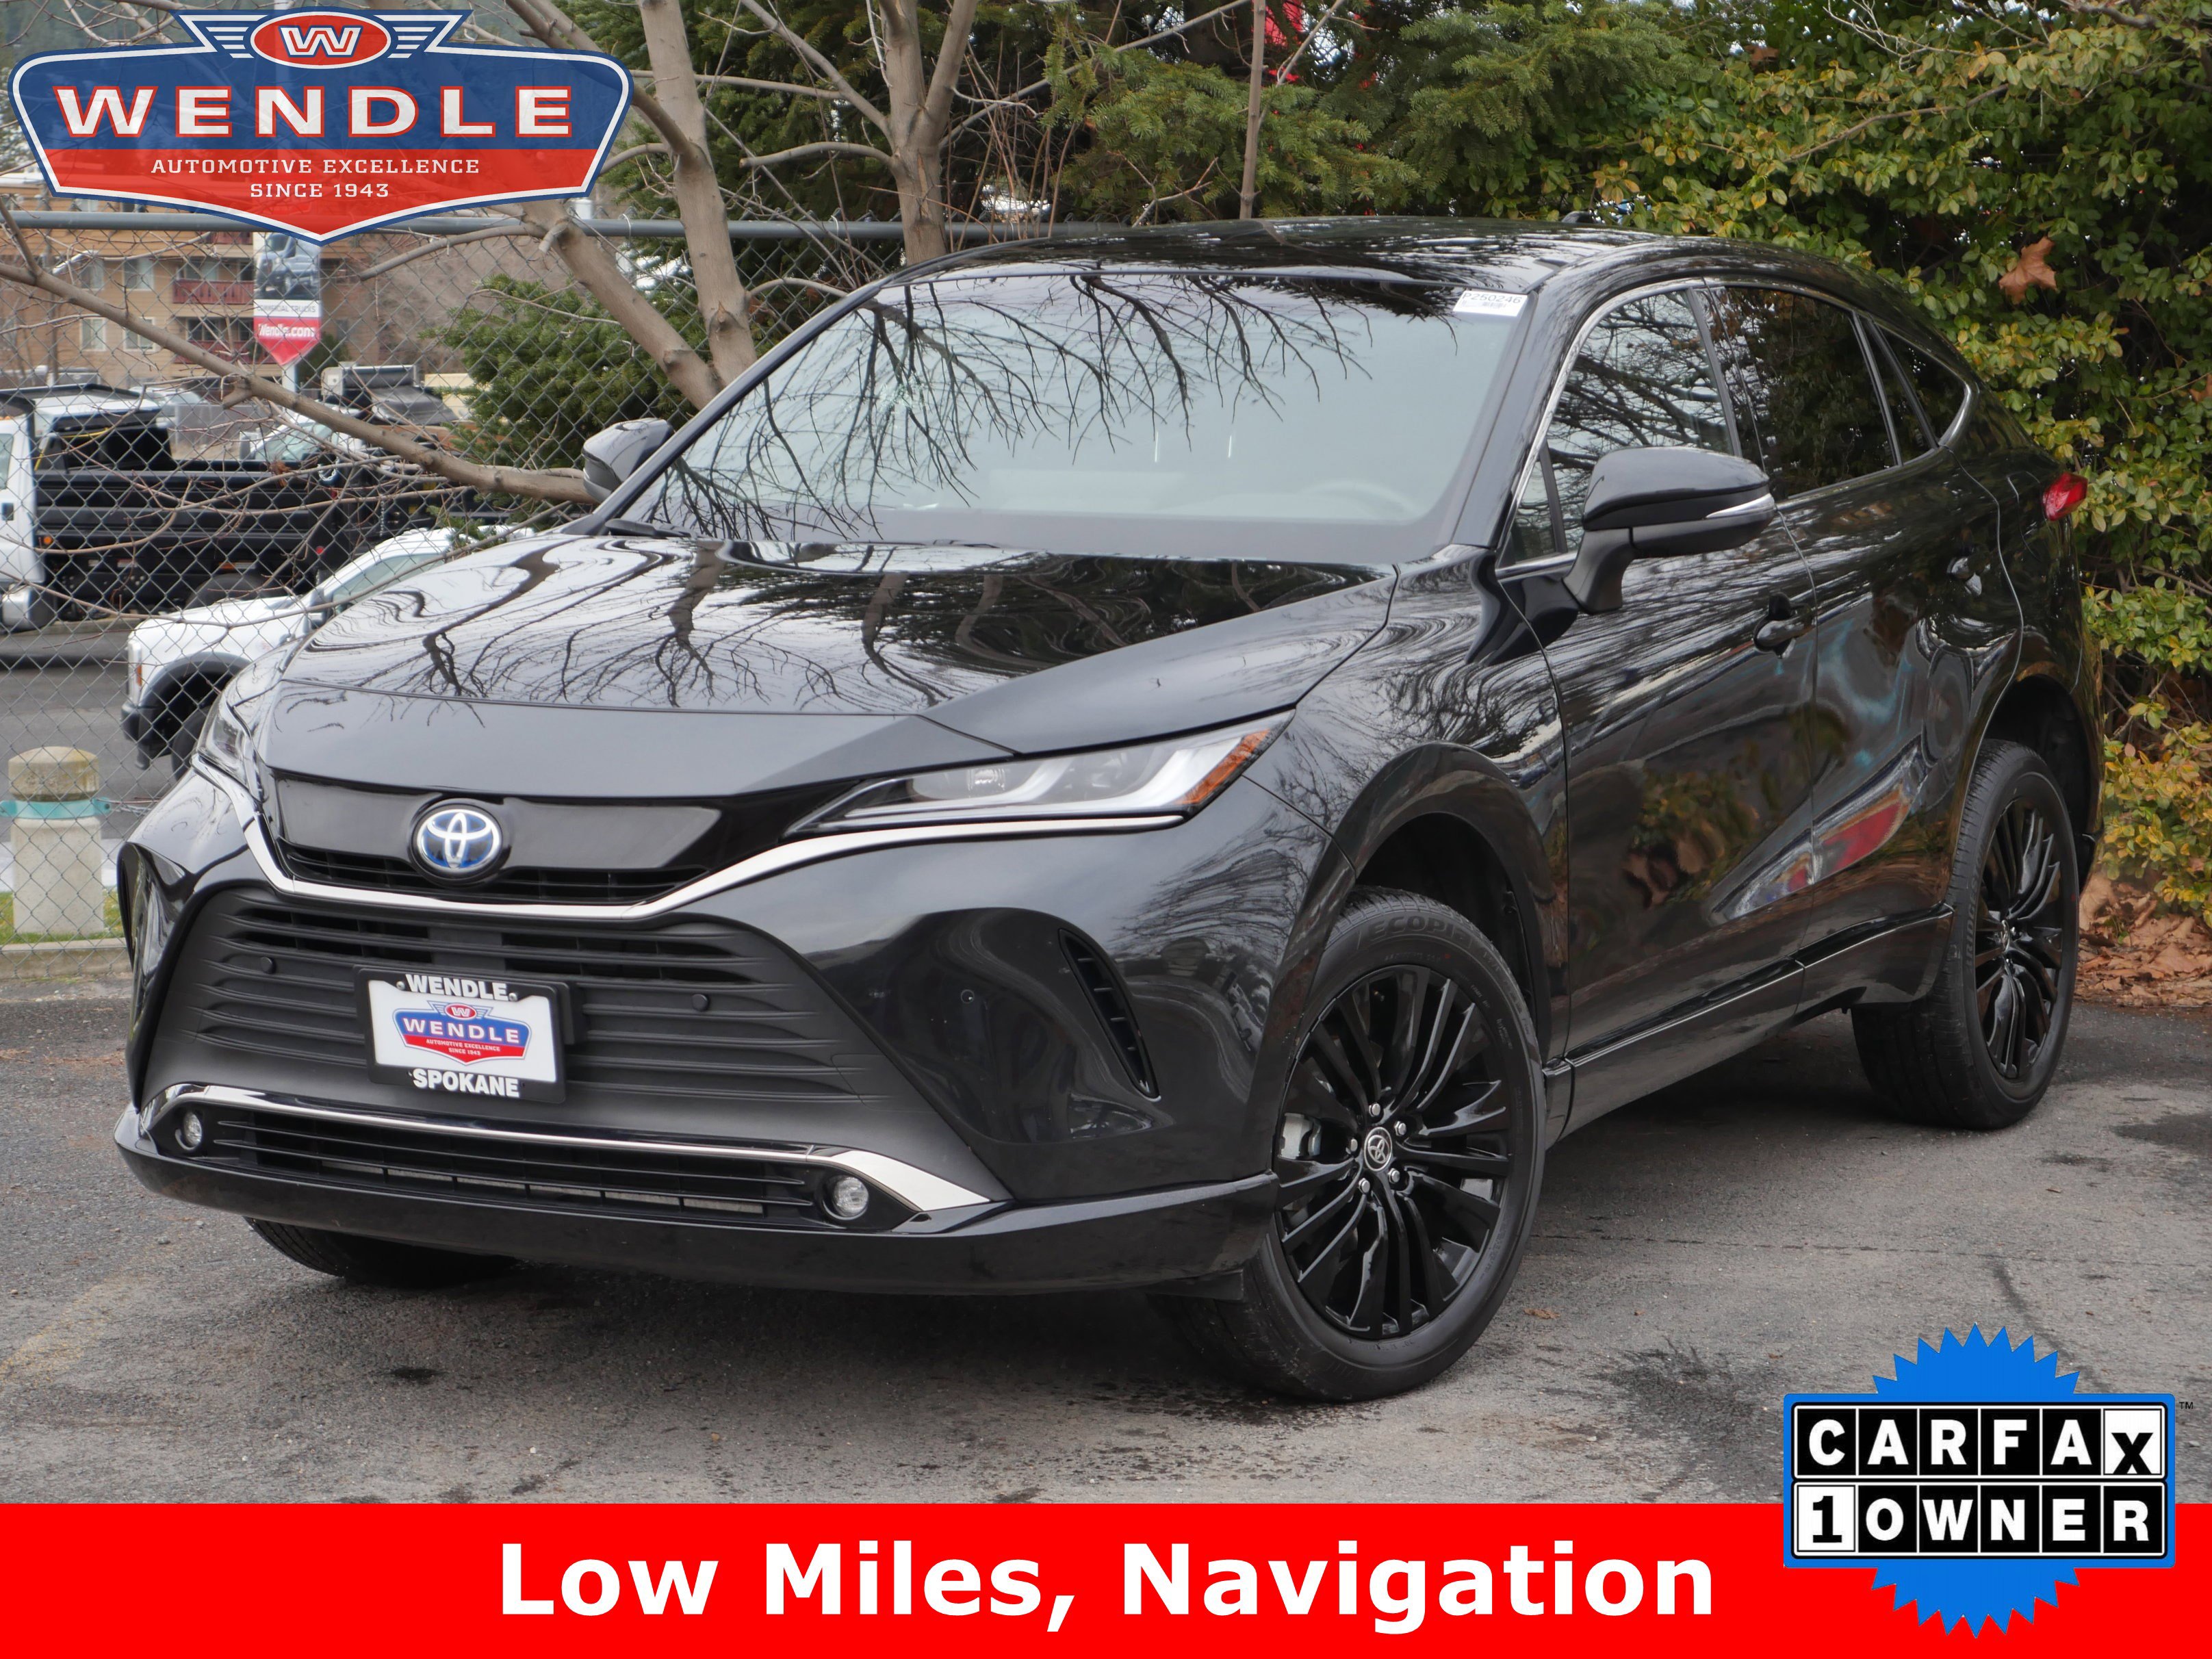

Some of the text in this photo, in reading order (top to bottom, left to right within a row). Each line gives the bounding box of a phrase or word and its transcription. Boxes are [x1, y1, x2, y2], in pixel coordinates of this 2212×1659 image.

[1462, 292, 1522, 304] P250246
[405, 974, 509, 1001] WENDLE
[403, 1018, 519, 1044] WENDLE
[426, 1039, 501, 1052] AUTOMOTIVE EXCELLENCE
[413, 1068, 520, 1098] SPOKANE
